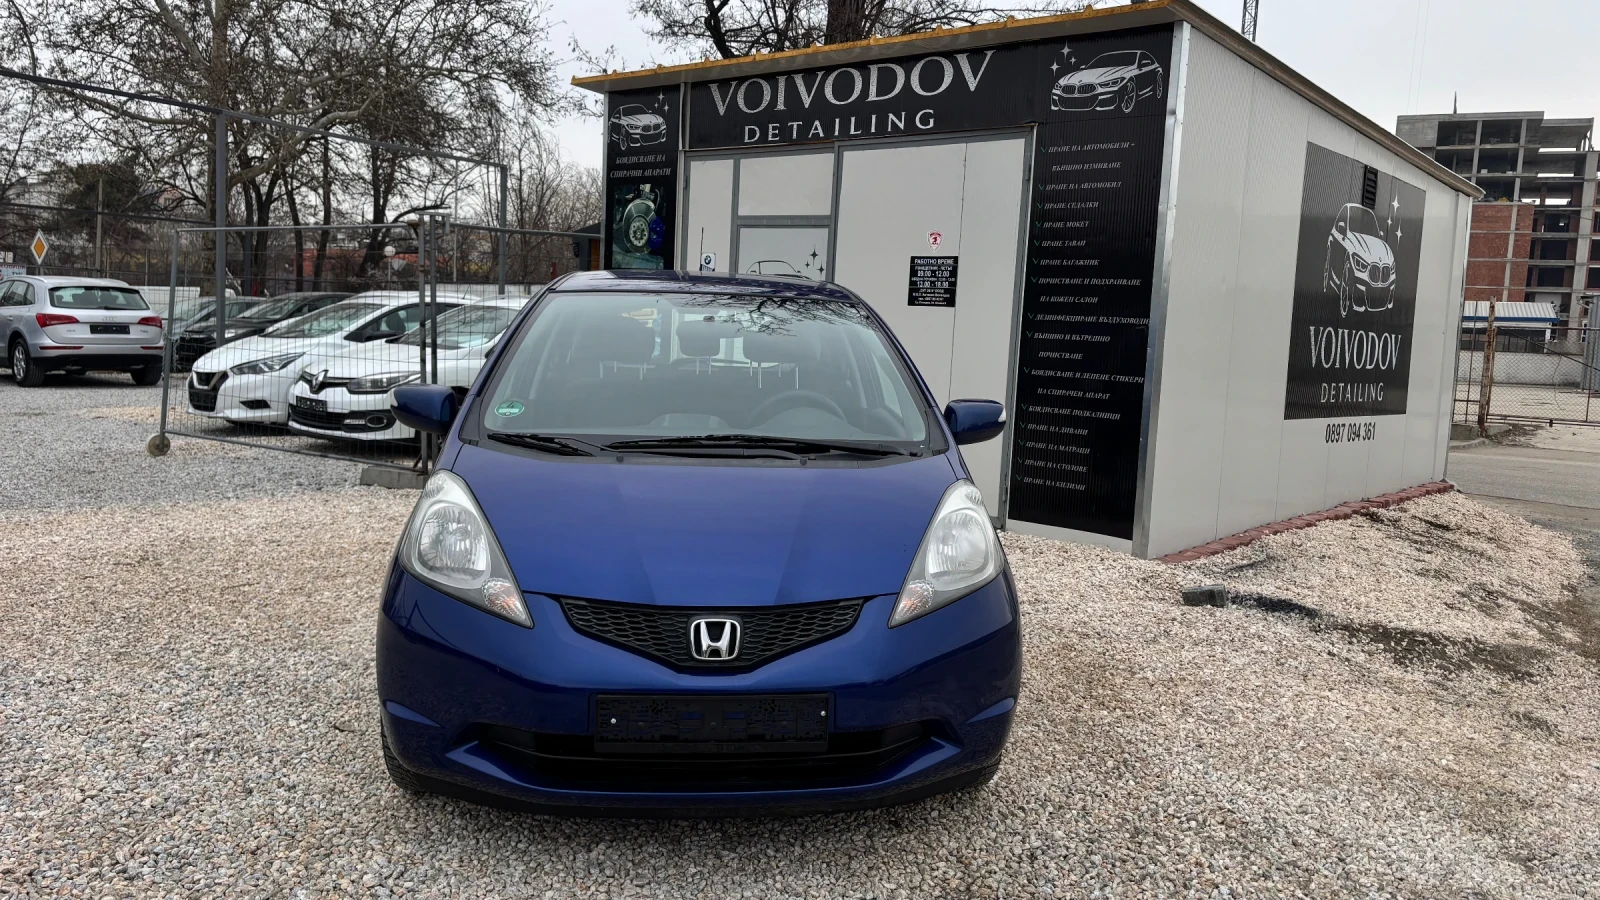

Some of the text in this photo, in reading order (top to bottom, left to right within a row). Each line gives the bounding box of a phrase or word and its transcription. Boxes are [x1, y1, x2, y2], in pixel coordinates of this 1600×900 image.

[708, 50, 996, 116] VOIVODOV
[744, 109, 935, 142] DETAILING
[1082, 142, 1129, 150] АВТОМОБИЛИ
[616, 155, 656, 164] БОЯДИСВАНЕ
[610, 168, 671, 178] СПИРАЧНИ АПАРАТИ
[1310, 326, 1401, 370] VOIVODOV
[1031, 369, 1074, 378] БОЯДИСВАНЕ
[1111, 375, 1144, 383] СТИКЕРИ
[1048, 388, 1083, 397] СПИРАЧЕН
[1321, 383, 1384, 402] DETAILING
[1029, 406, 1071, 415] БОЯДИСВАНЕ
[1059, 426, 1088, 435] ДИВАНИ
[1325, 422, 1376, 443] 0897 094 361
[1058, 445, 1090, 454] МАТРАЦИ
